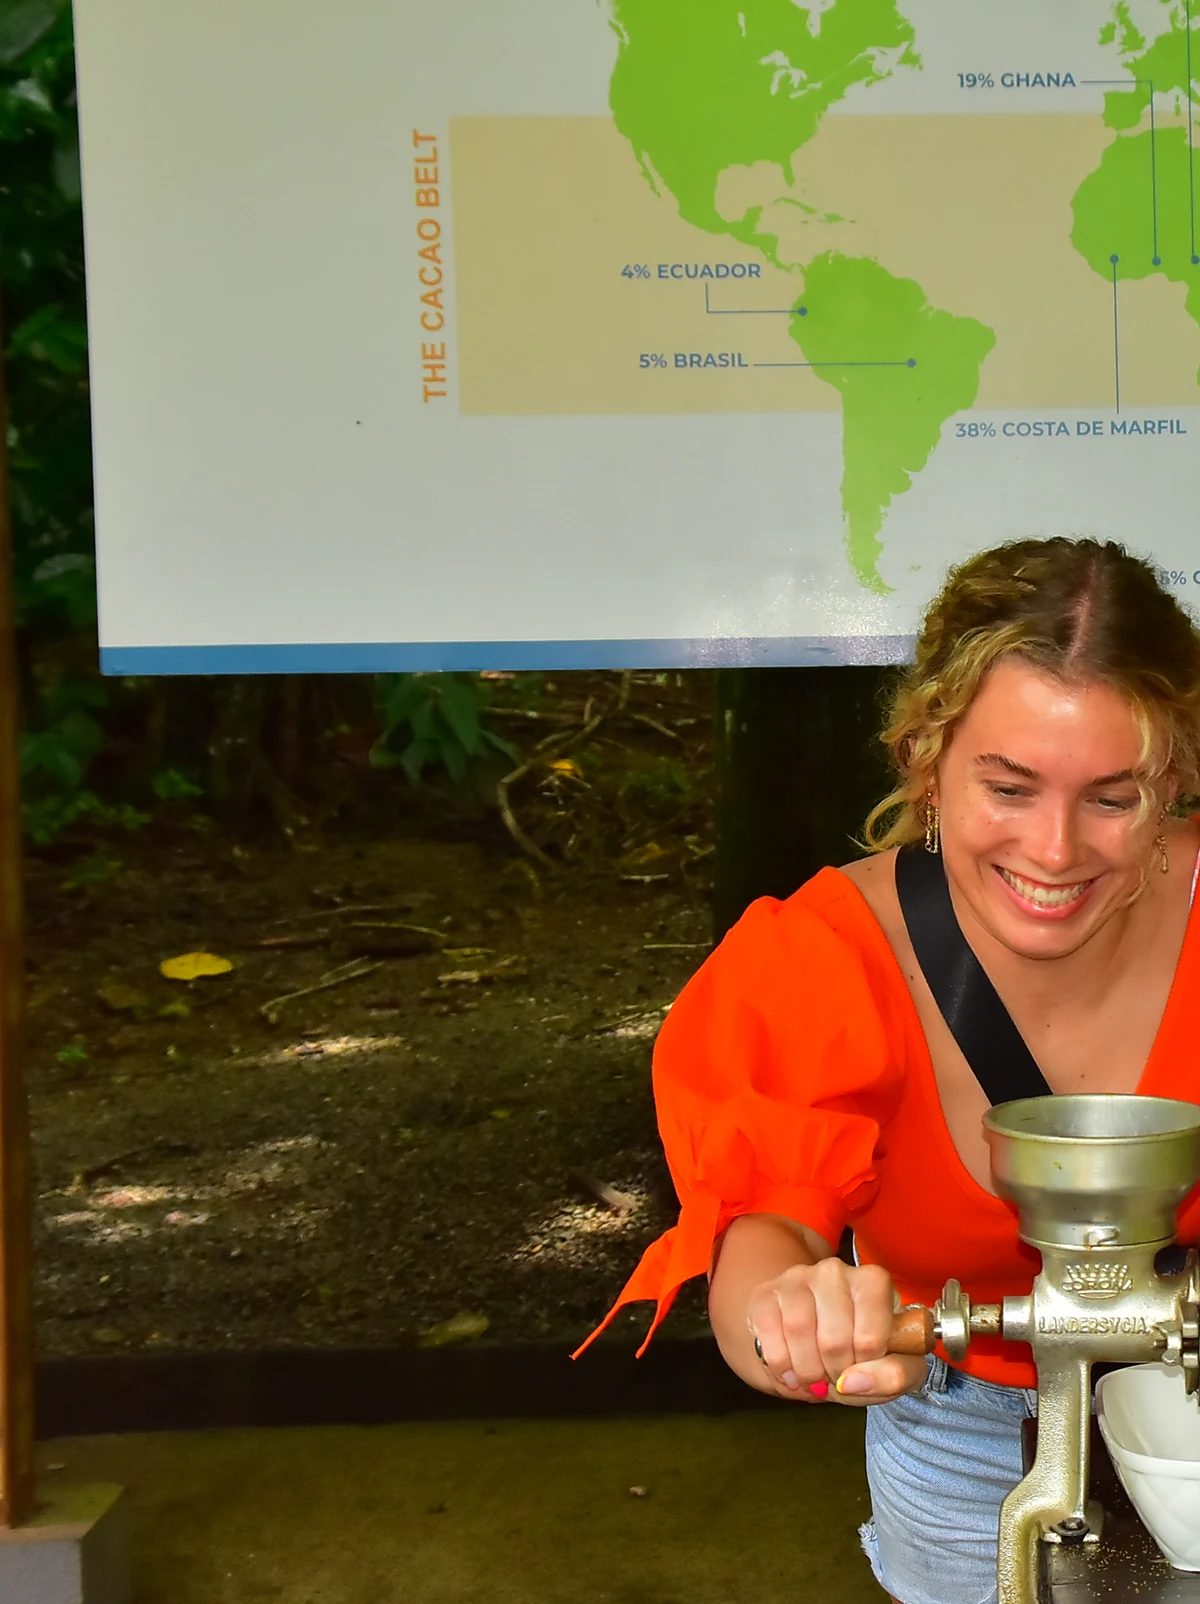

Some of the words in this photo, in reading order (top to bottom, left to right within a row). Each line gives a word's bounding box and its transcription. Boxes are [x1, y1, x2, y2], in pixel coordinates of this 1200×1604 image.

[957, 73, 994, 88] 19%
[1001, 73, 1076, 88] GHANA
[414, 129, 440, 207] BELT
[416, 218, 444, 331] CACAO
[621, 265, 651, 279] 4%
[658, 263, 762, 279] ECUADOR
[639, 353, 668, 368] 5%
[674, 352, 749, 369] BRASIL
[421, 342, 446, 402] THE
[955, 422, 996, 438] 38%
[1002, 421, 1070, 438] COSTA
[1076, 420, 1104, 437] DE
[1110, 419, 1187, 437] MARFIL
[1062, 1278, 1133, 1292] CORONA
